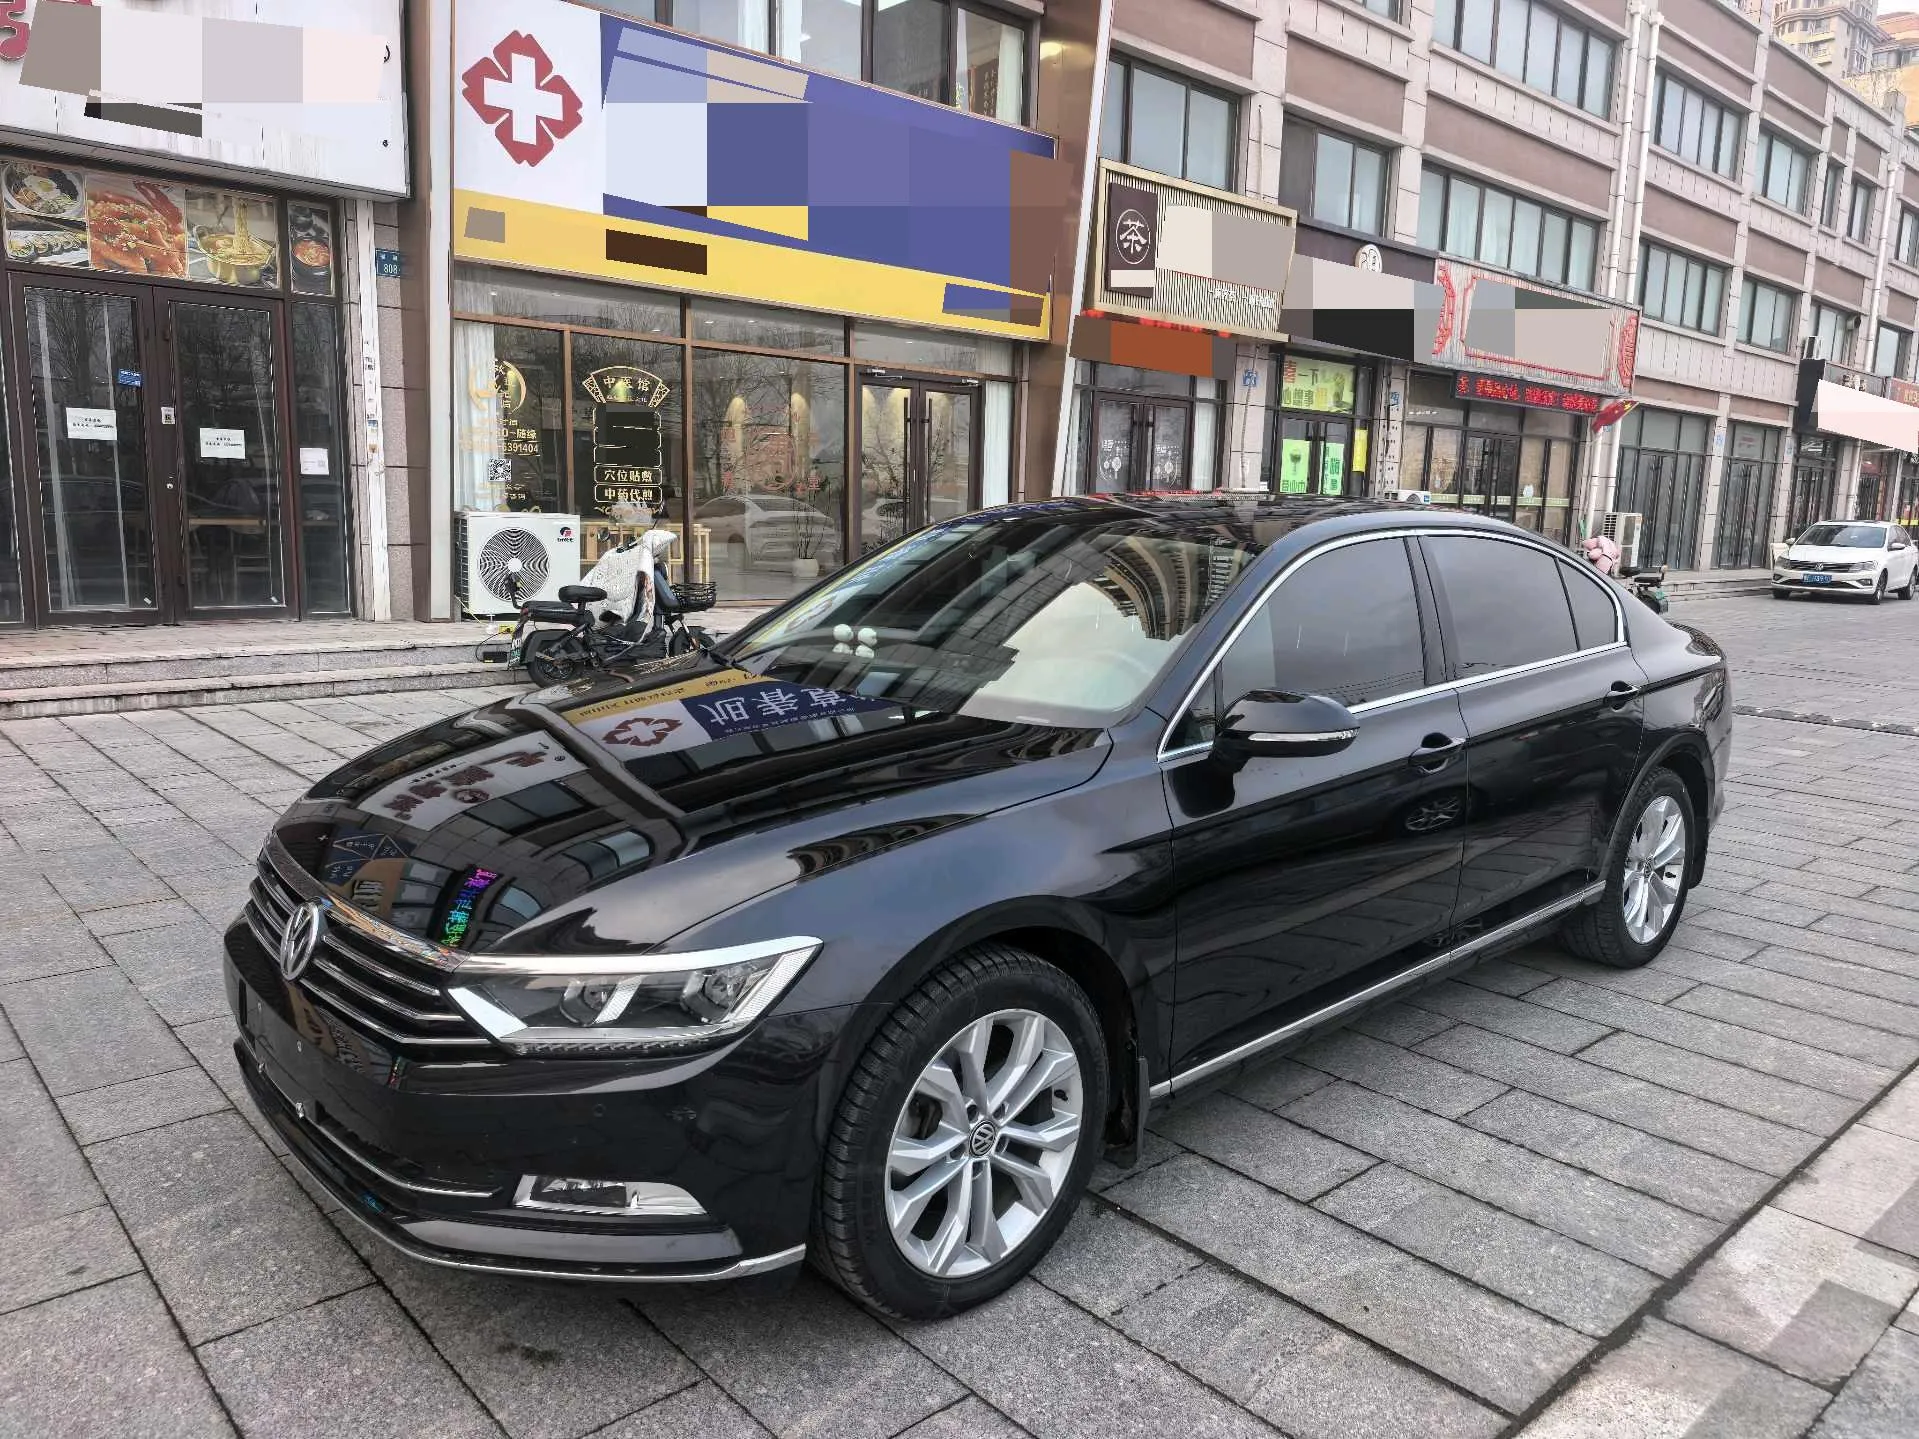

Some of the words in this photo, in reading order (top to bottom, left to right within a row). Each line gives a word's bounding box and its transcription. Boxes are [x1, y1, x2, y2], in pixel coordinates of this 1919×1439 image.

[1119, 218, 1148, 255] 茶
[603, 375, 651, 393] 中医馆
[604, 470, 653, 483] 穴位贴敷
[604, 488, 653, 502] 中药代煎
